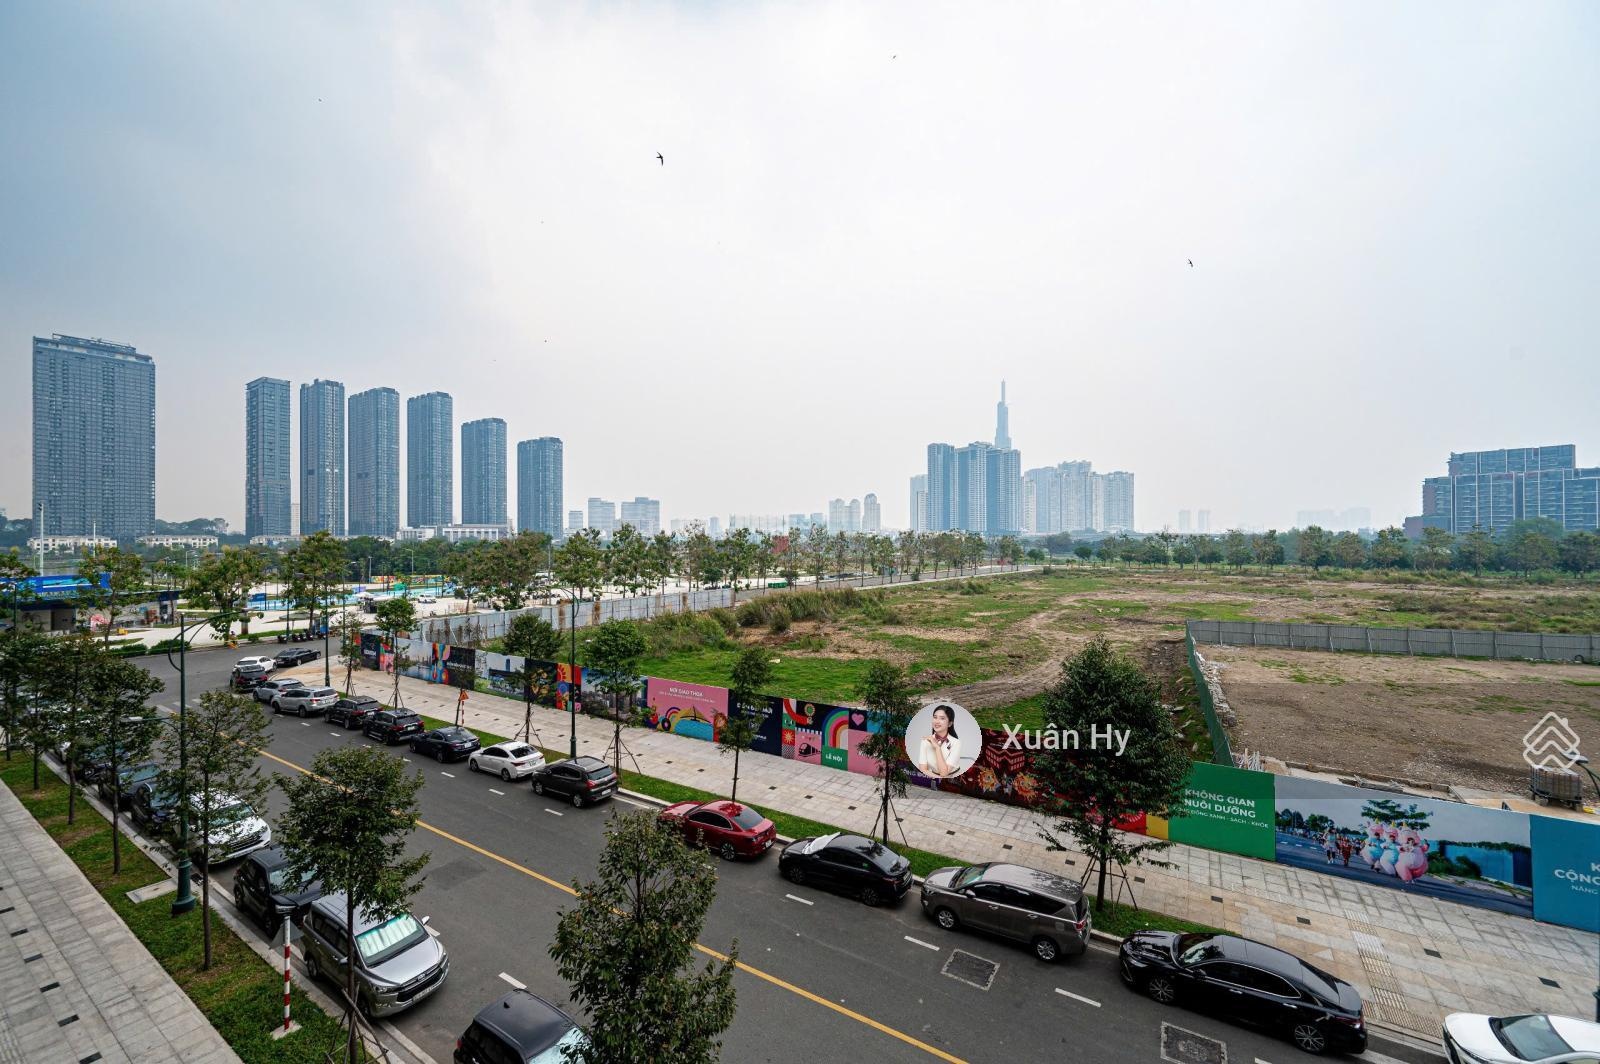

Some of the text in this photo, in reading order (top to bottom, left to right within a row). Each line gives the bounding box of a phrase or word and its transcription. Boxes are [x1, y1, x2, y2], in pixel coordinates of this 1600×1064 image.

[1185, 789, 1254, 808] KHÔNG GIAN
[1184, 799, 1211, 810] NUÔI
[1214, 804, 1256, 818] DƯỠNG
